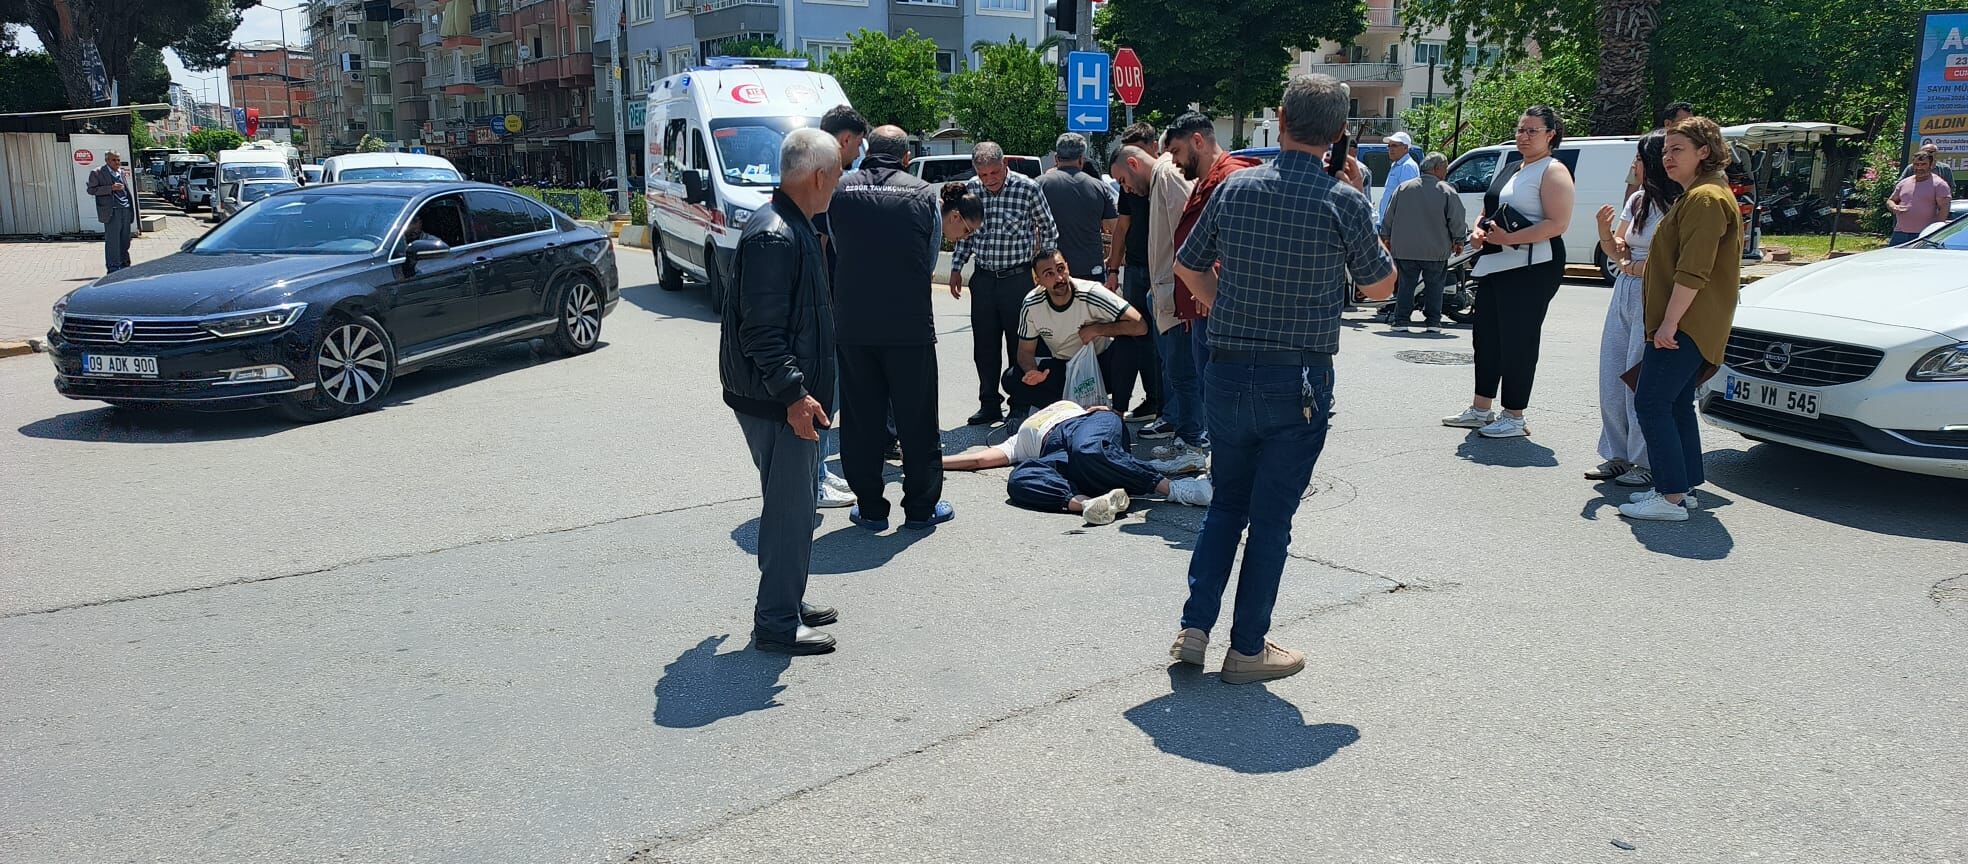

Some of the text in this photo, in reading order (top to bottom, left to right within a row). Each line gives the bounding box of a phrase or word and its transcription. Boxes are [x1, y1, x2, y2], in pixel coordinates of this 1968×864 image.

[1955, 57, 1968, 66] 23
[1077, 62, 1101, 100] H
[1115, 66, 1142, 88] DUR
[1927, 85, 1951, 93] SAYIN
[1924, 117, 1967, 130] ALDIN
[89, 356, 156, 373] 09 ADK 900
[1733, 380, 1817, 414] 45 VM 545
